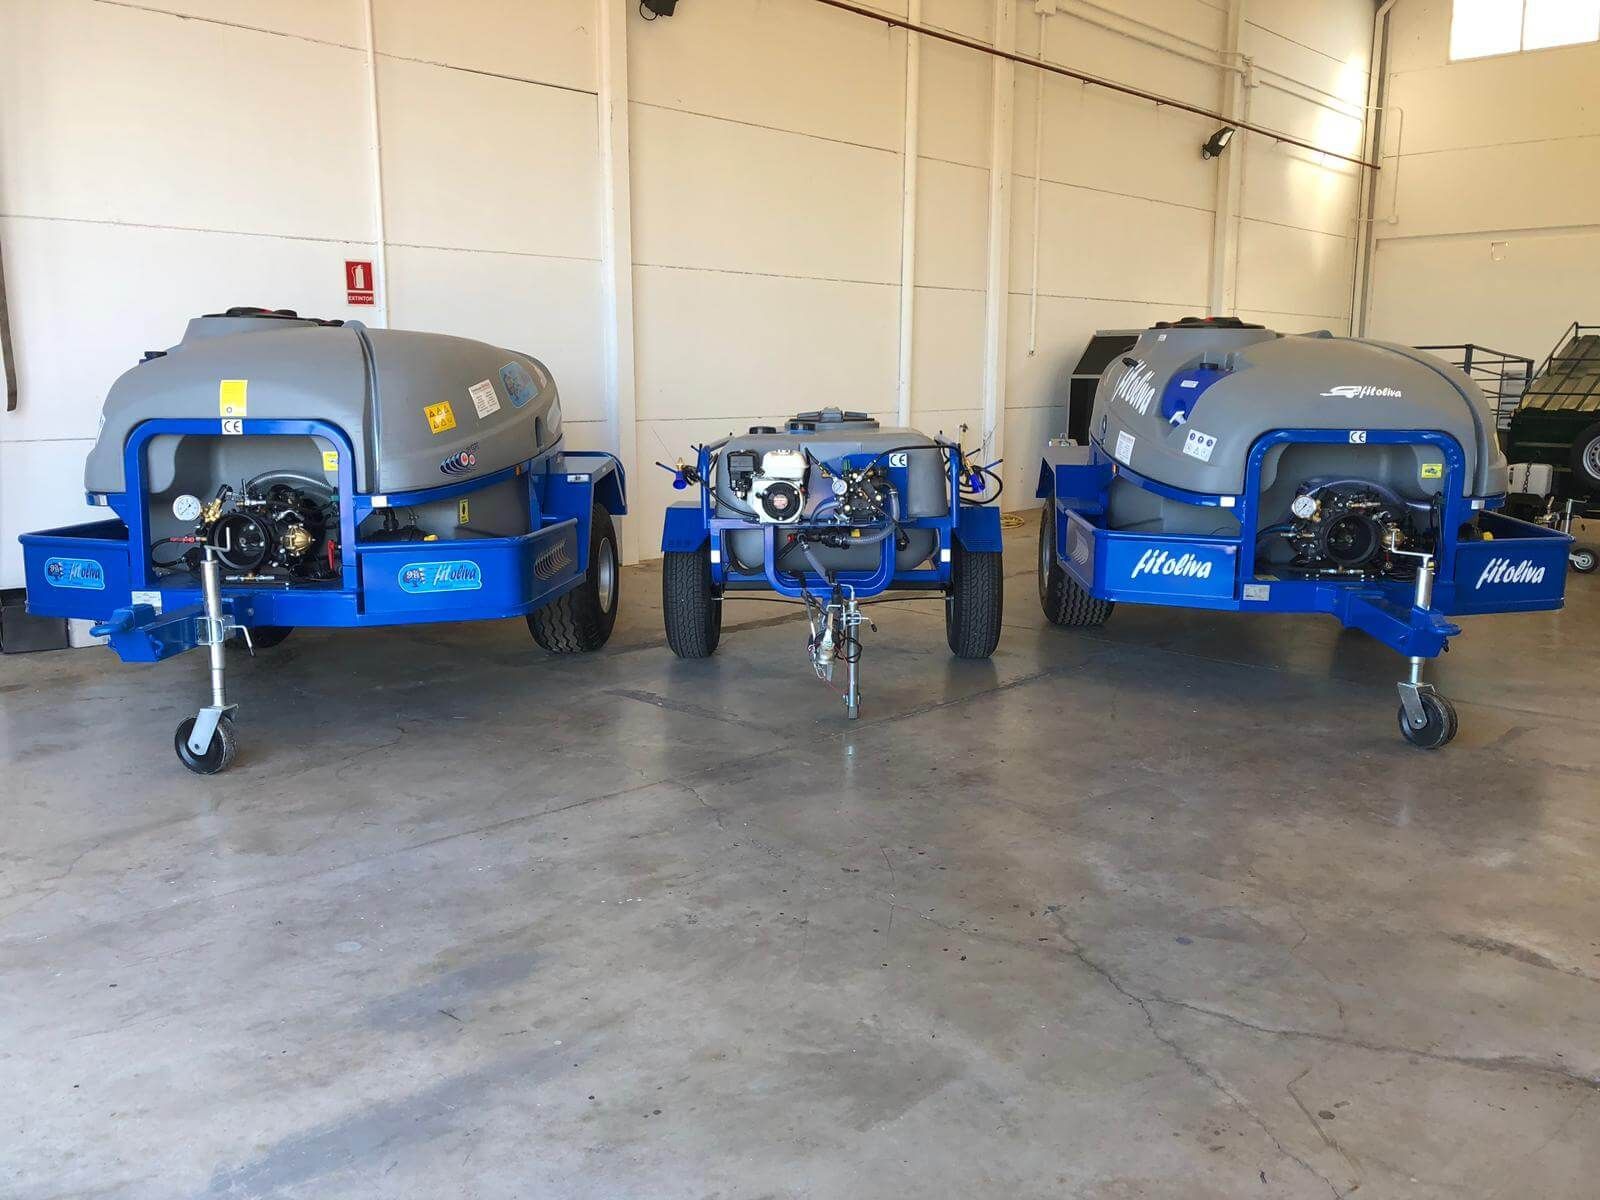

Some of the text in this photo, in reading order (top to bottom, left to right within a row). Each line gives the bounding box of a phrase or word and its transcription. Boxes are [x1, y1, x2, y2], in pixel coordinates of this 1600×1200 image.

[1112, 359, 1156, 416] fitoliva
[1360, 385, 1402, 399] fitoliva
[223, 420, 241, 433] CE
[1350, 431, 1366, 443] CE
[890, 453, 906, 467] CE
[1130, 548, 1213, 579] fitoliva
[1475, 557, 1546, 590] fitoliva
